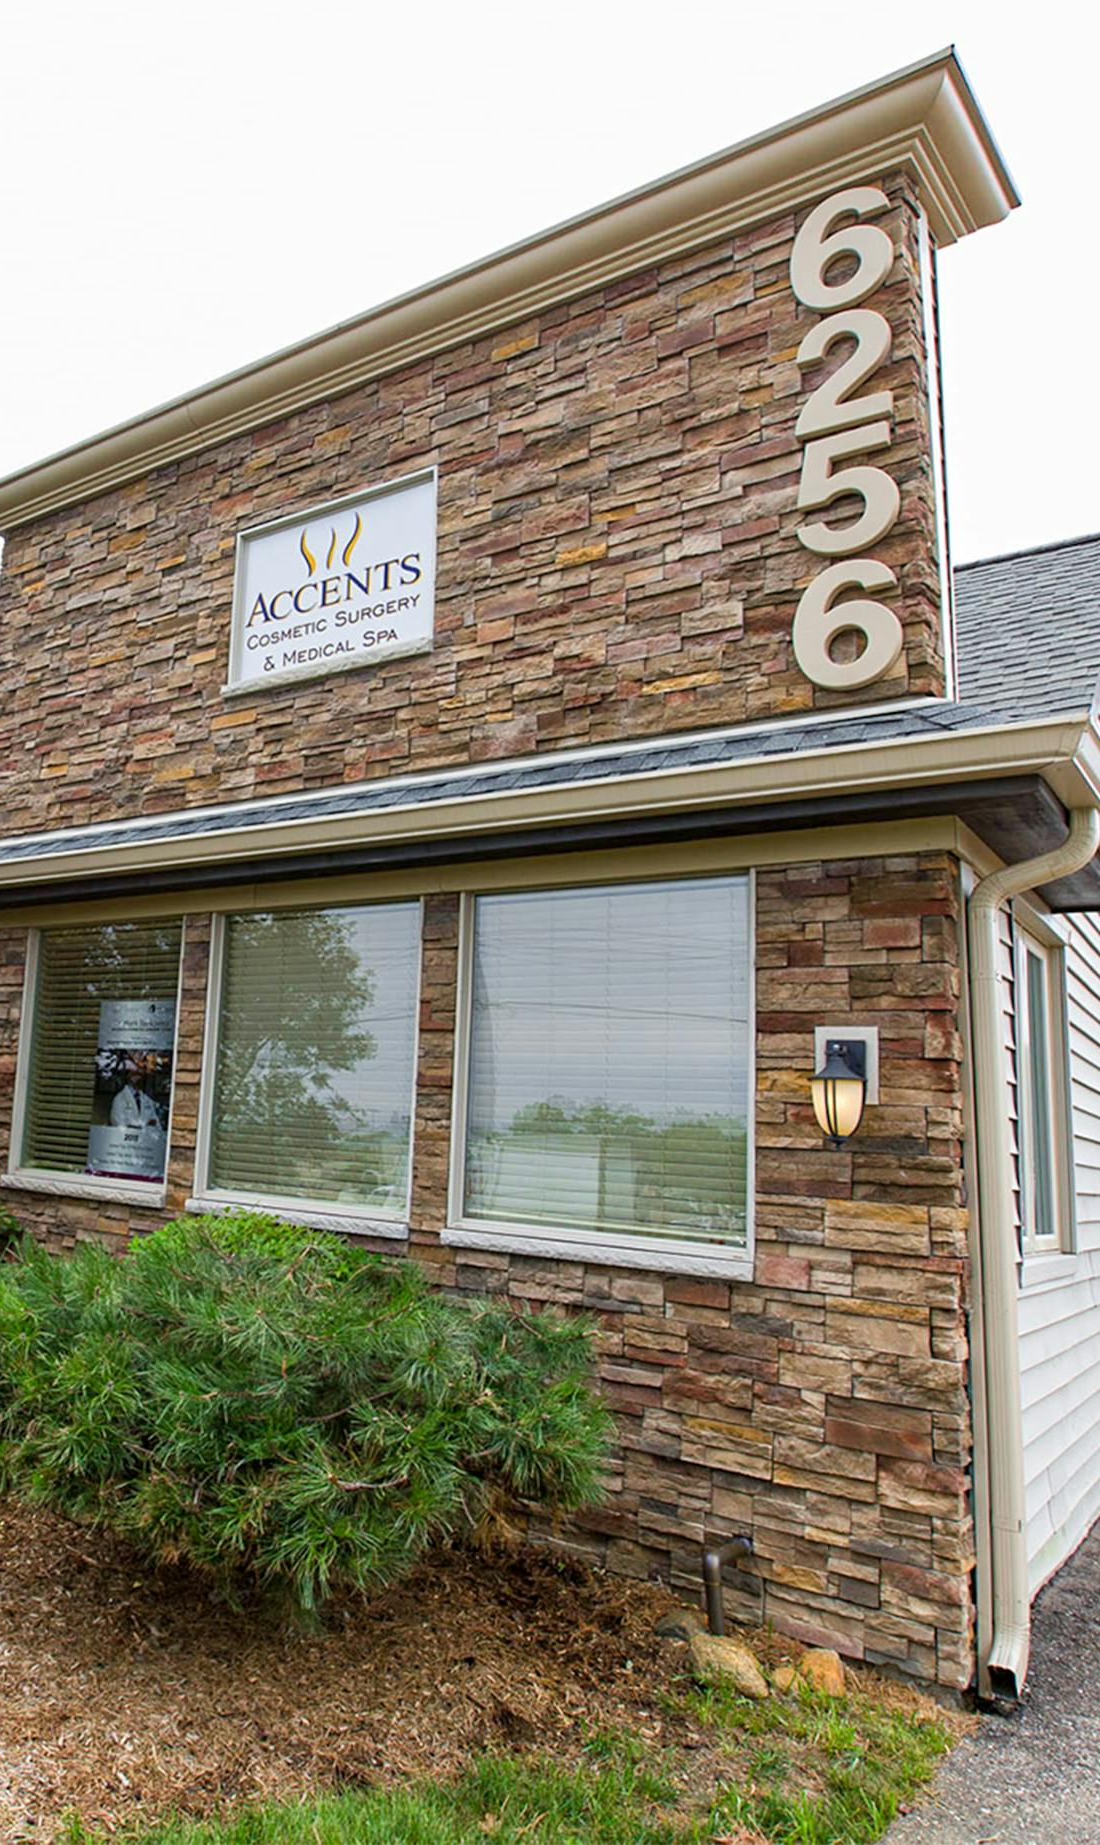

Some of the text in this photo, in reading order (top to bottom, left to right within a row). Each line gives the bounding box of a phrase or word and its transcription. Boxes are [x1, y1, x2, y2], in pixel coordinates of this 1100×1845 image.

[790, 186, 903, 691] 6256
[246, 553, 422, 628] ACCENTS
[246, 594, 421, 650] COSMETIC SURGERY
[263, 628, 398, 672] & MEDICAL SPA
